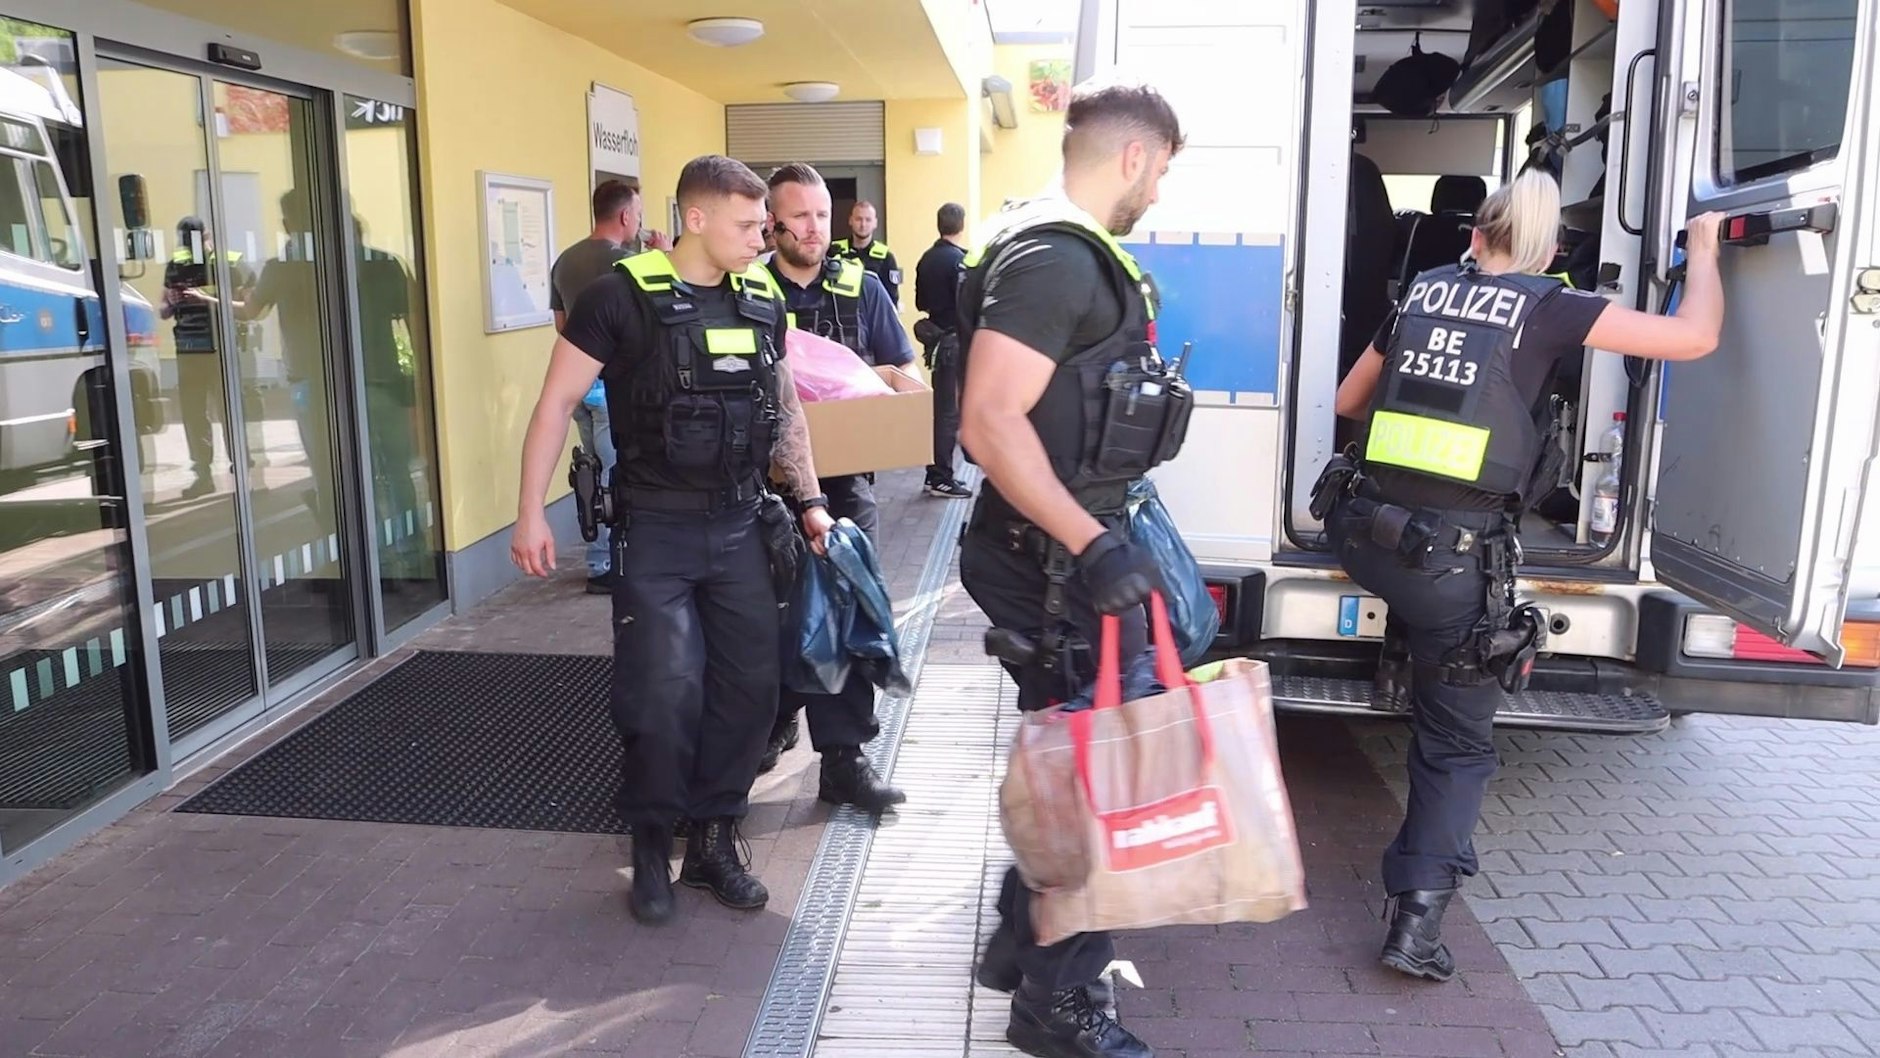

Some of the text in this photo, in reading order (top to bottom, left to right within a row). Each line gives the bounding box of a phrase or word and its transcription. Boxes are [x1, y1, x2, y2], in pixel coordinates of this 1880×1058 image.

[593, 121, 639, 156] Wasserfloh
[1402, 280, 1526, 329] POLIZEI
[1427, 327, 1467, 355] BE
[1399, 349, 1478, 386] 25113
[1344, 619, 1353, 629] D
